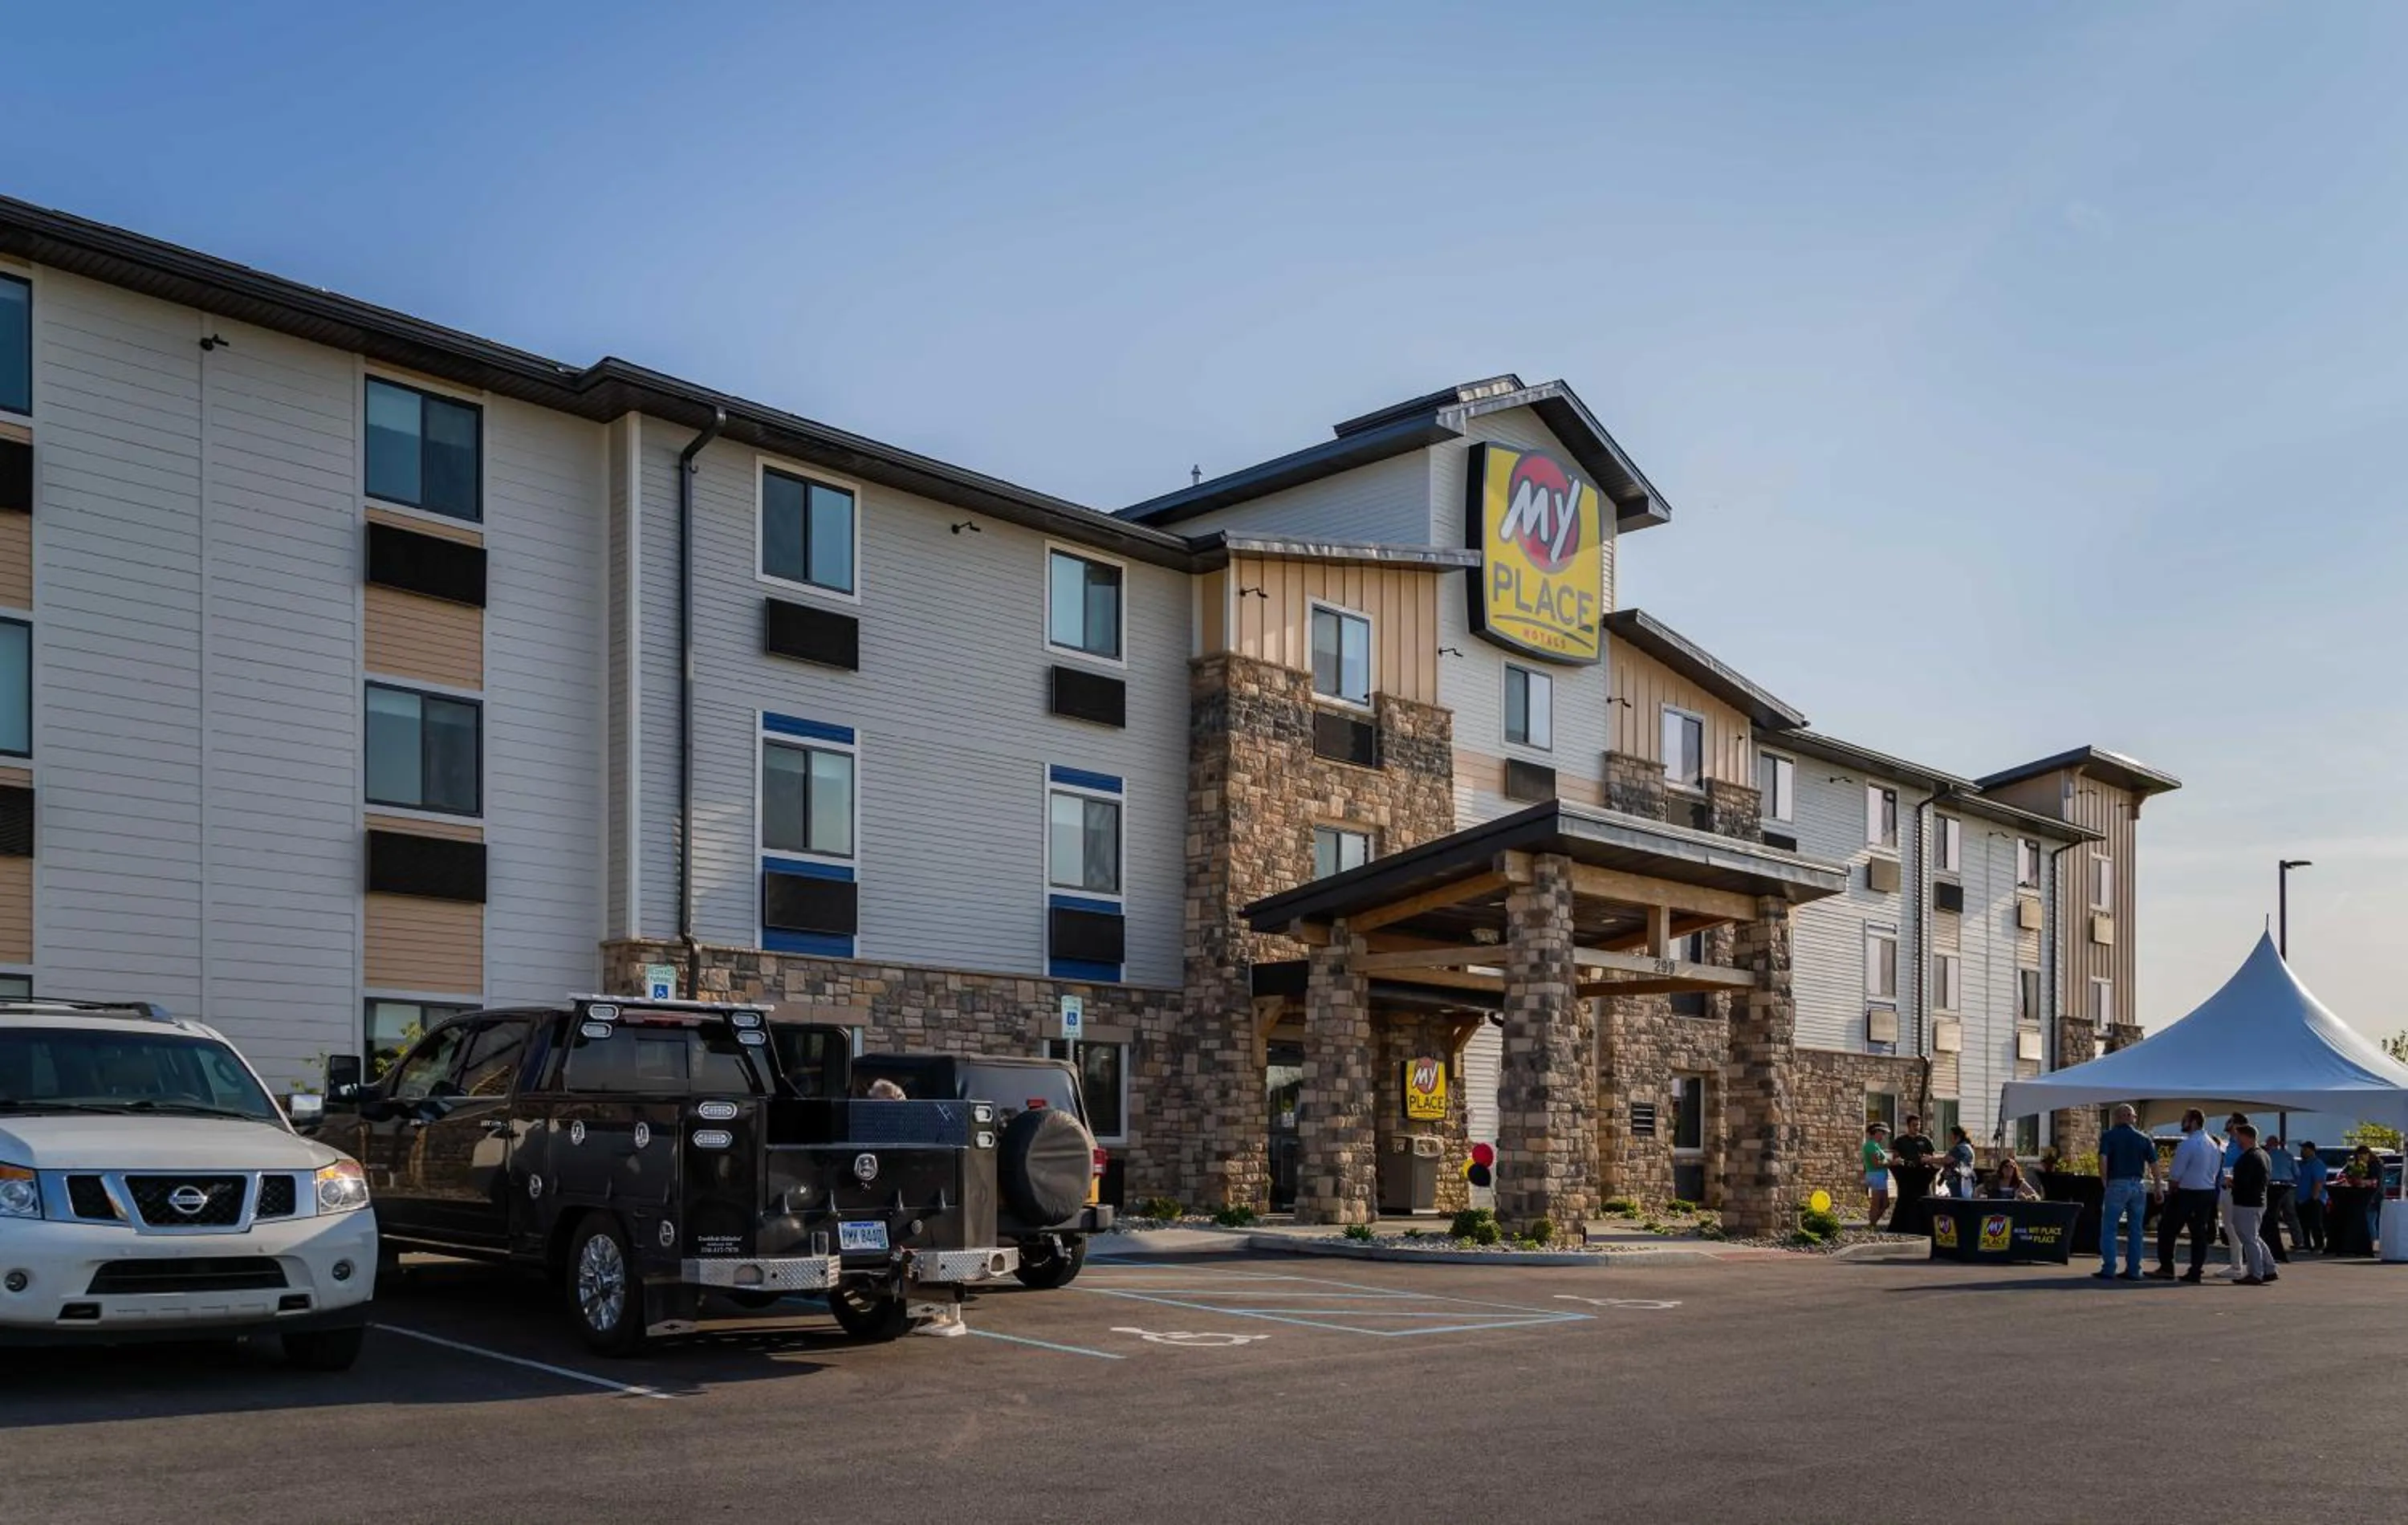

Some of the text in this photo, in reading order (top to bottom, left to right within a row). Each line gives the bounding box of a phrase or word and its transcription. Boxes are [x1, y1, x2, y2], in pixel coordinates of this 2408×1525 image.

[1499, 478, 1581, 563] MY
[1492, 561, 1593, 628] PLACE
[1654, 959, 1675, 974] 299
[1412, 1061, 1438, 1091] MY
[1409, 1094, 1444, 1109] PLACE
[1986, 1218, 2007, 1235] MY
[2040, 1227, 2062, 1235] PLACE
[2033, 1235, 2056, 1243] PLACE
